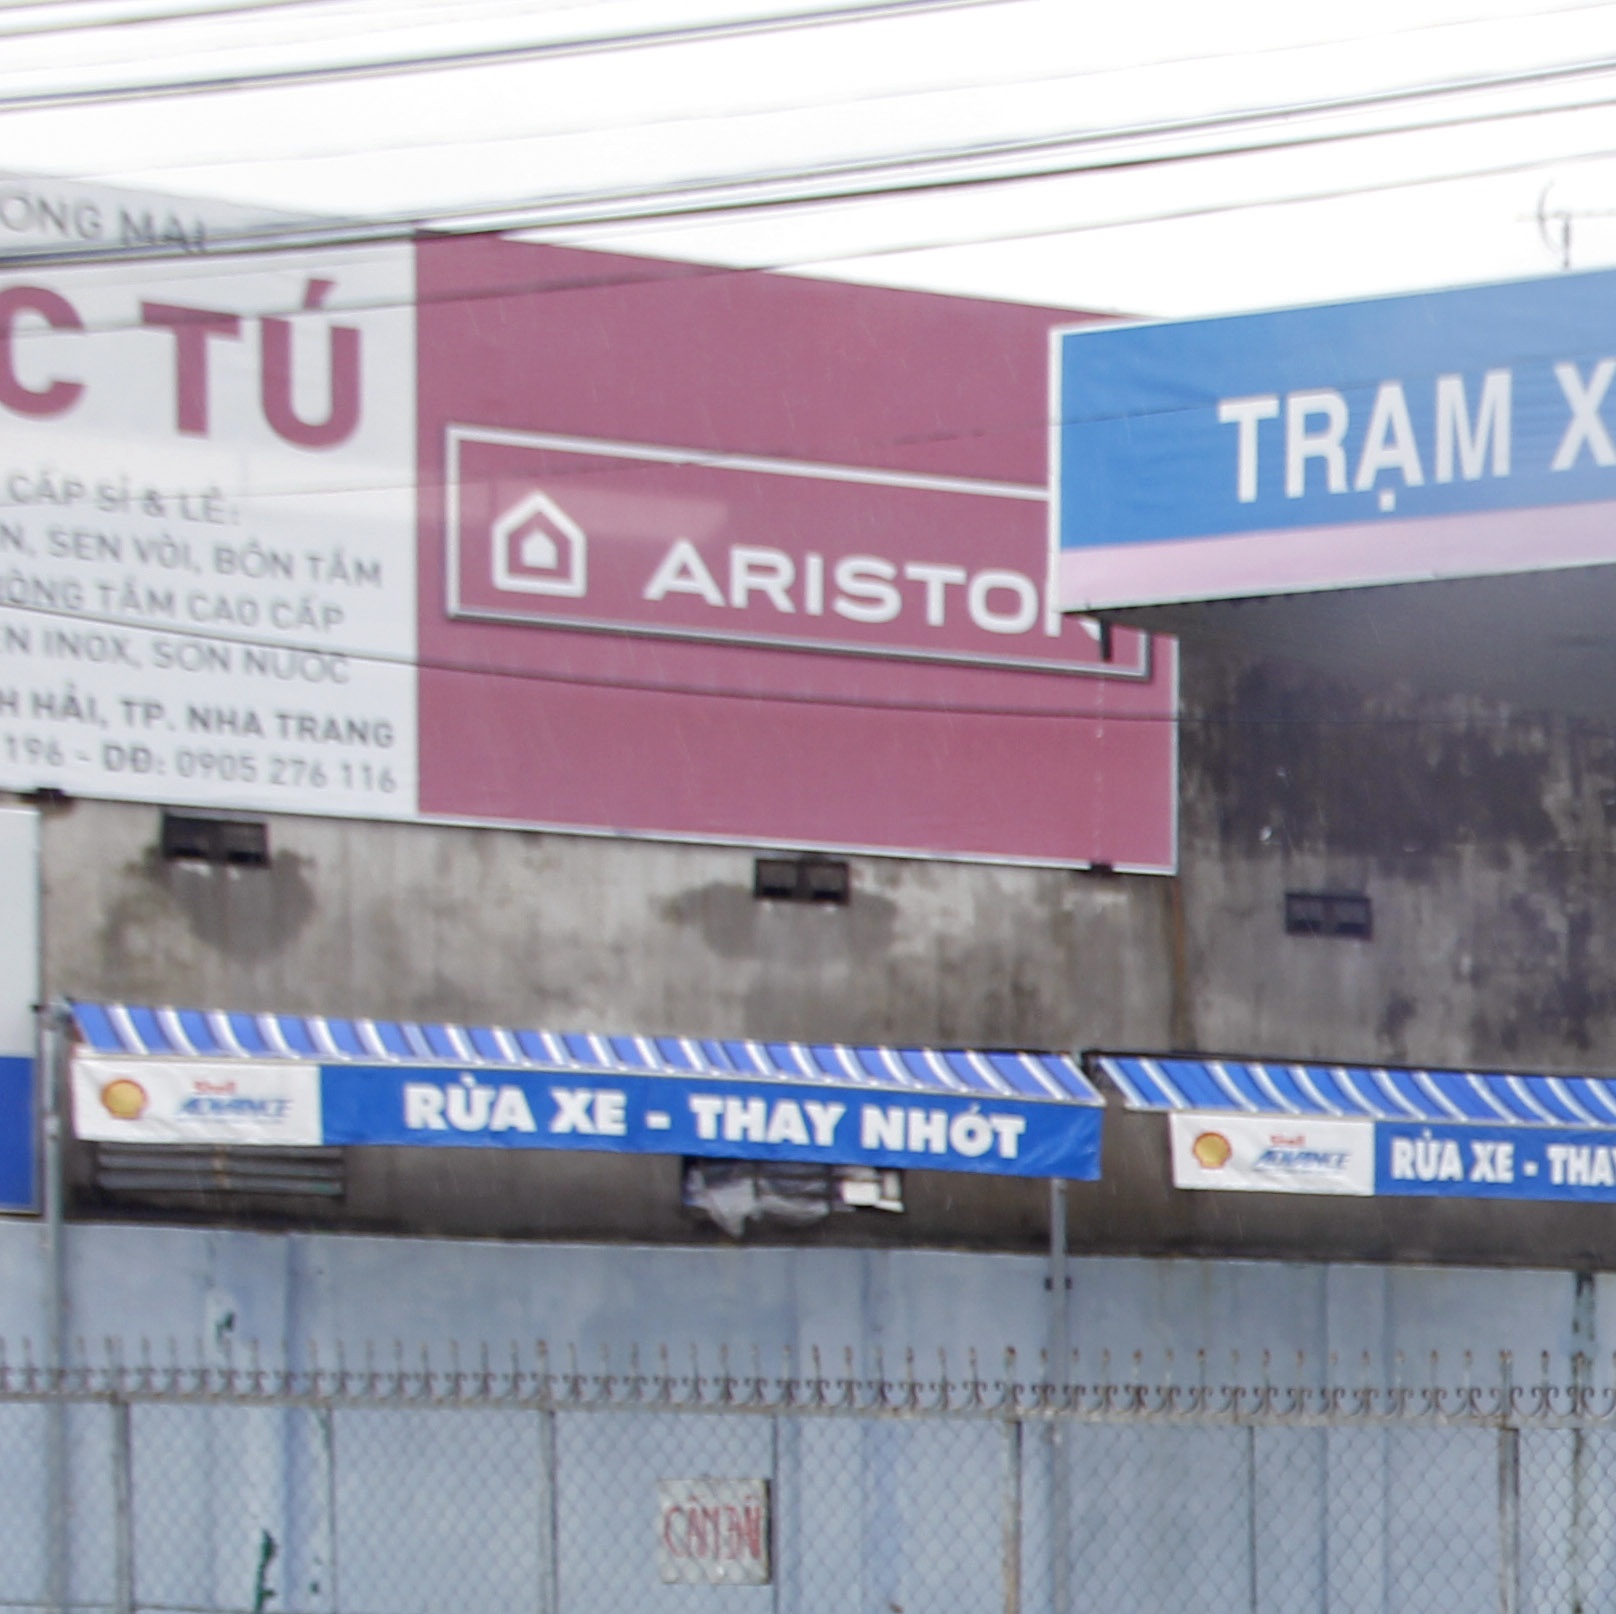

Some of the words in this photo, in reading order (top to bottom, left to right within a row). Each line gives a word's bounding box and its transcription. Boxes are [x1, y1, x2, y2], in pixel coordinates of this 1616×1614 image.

[140, 277, 363, 452] TÚ
[1219, 369, 1512, 513] TRẠM
[142, 488, 166, 519] &
[47, 527, 123, 564] SEN
[186, 591, 260, 627] CAO
[118, 697, 176, 733] TP.
[187, 703, 266, 740] NHA
[273, 710, 396, 750] TRANG
[175, 747, 259, 784] 0905
[266, 754, 329, 790] 276
[338, 759, 399, 795] 116
[403, 1071, 537, 1133] RỬA
[549, 1086, 628, 1136] XE
[688, 1093, 846, 1147] THAY
[1390, 1127, 1464, 1183] RỬA
[1469, 1139, 1516, 1184] XE
